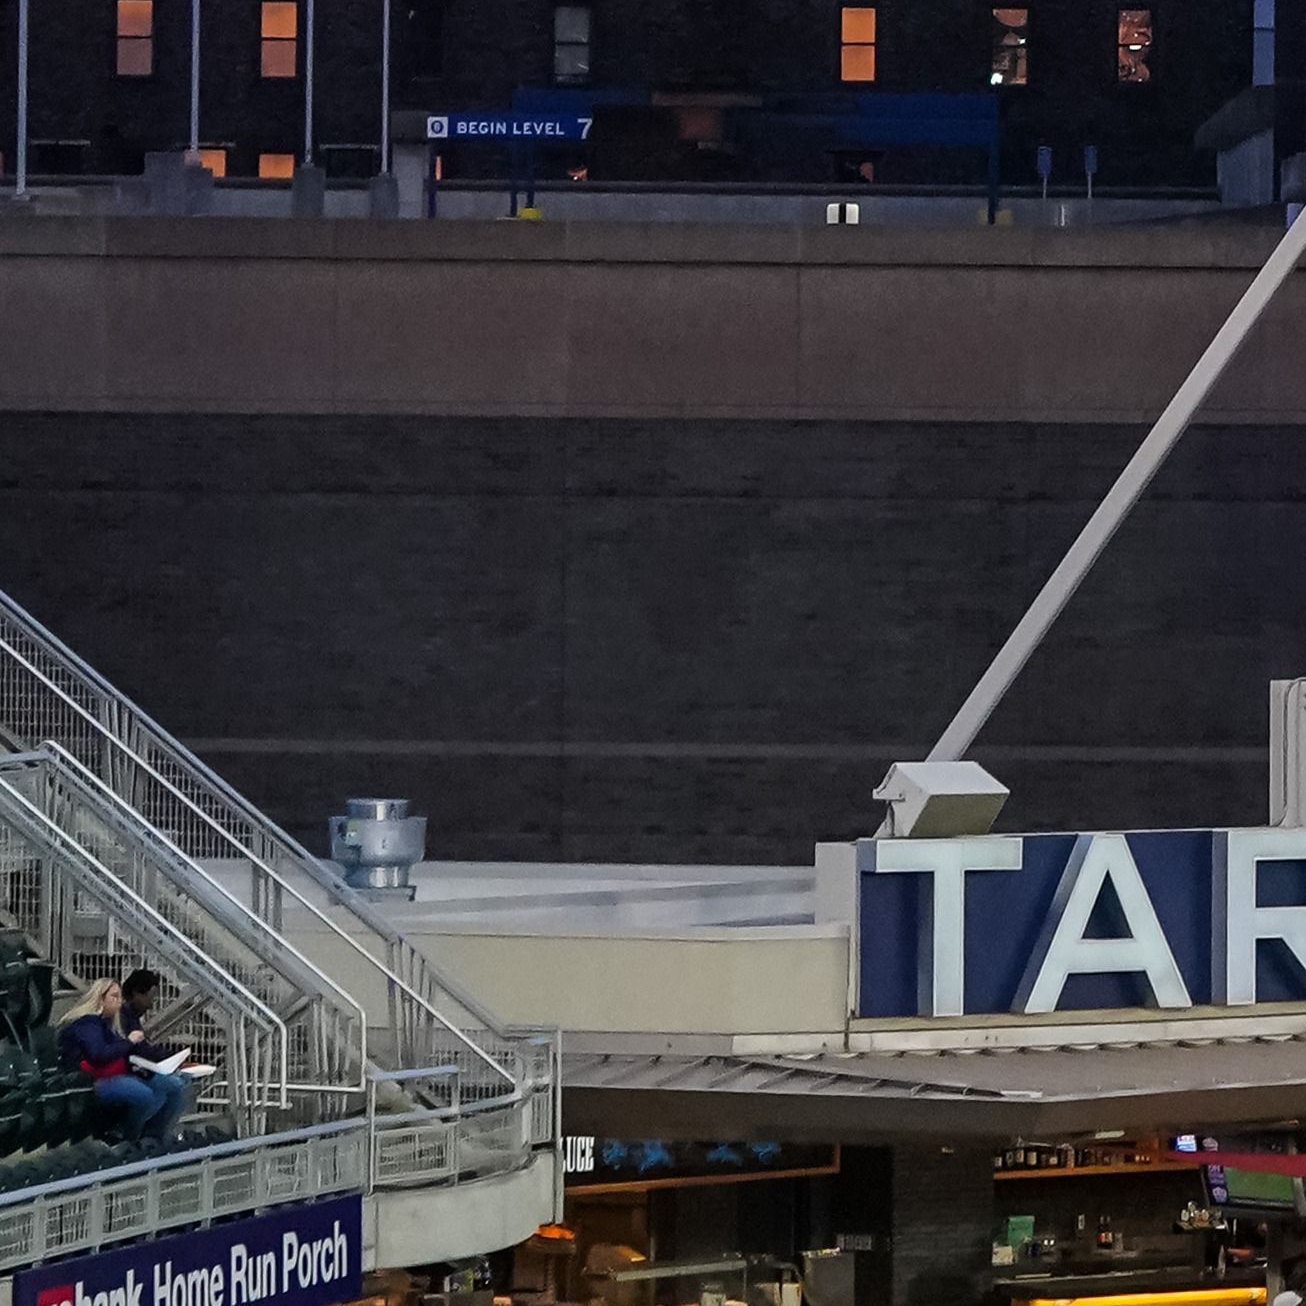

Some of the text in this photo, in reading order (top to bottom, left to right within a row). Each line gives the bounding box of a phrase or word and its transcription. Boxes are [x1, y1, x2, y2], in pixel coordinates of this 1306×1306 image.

[456, 117, 593, 140] BEGIN LEVEL 7
[561, 1136, 595, 1173] UCE
[49, 1220, 348, 1306] bank Home Run Porch
